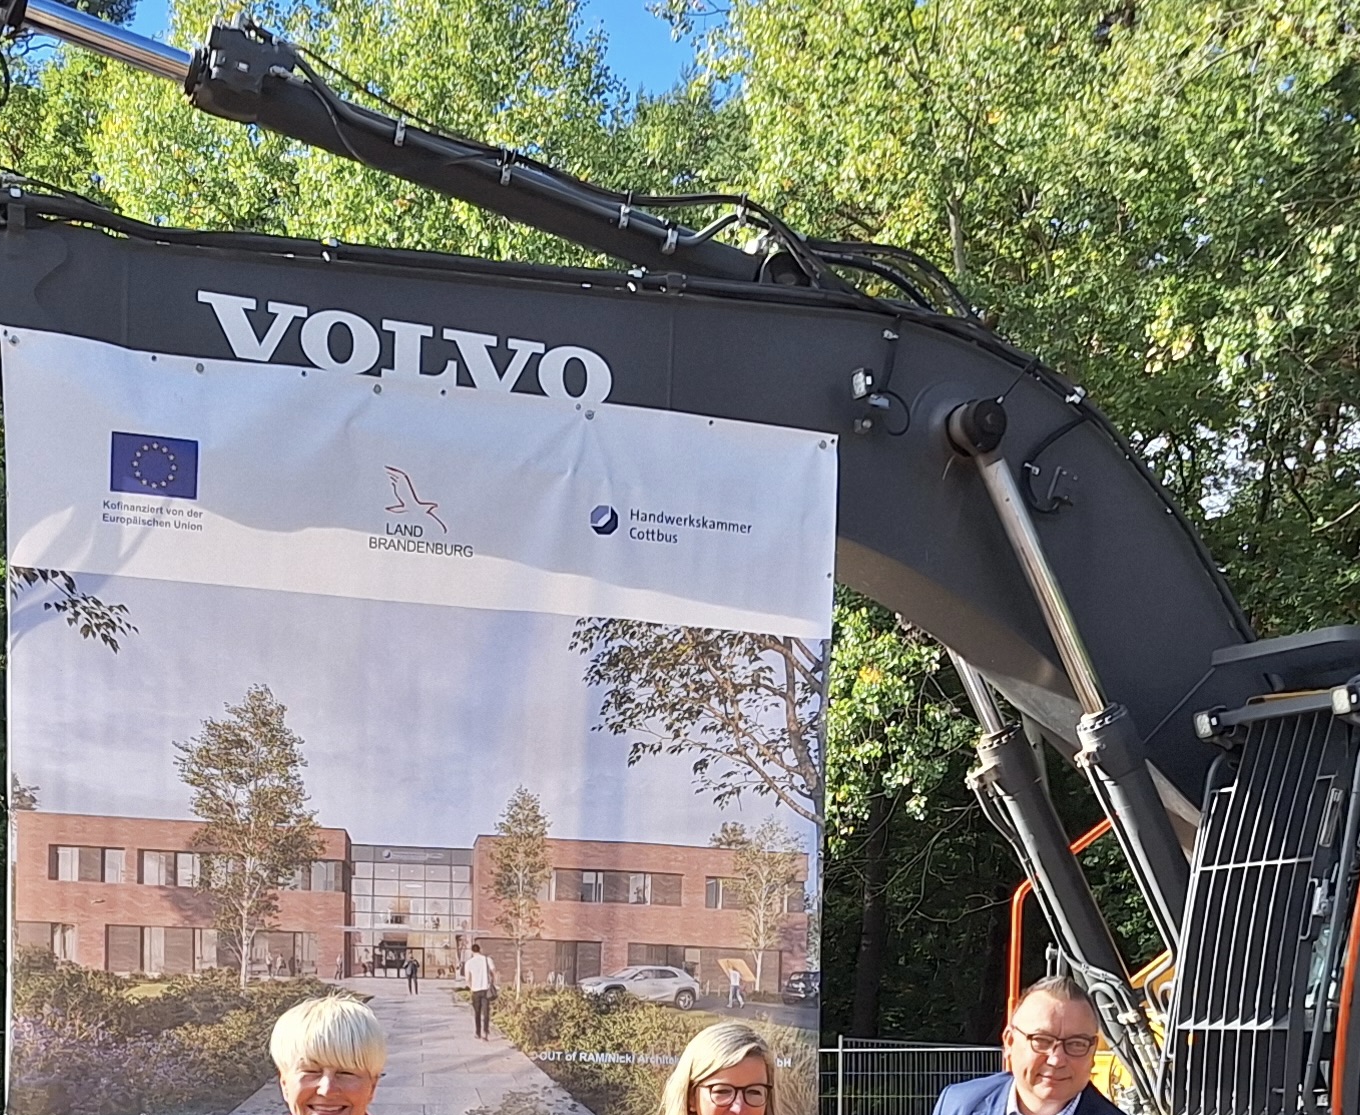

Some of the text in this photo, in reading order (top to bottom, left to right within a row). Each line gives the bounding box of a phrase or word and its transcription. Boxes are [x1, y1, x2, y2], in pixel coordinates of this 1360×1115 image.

[197, 290, 613, 404] VOLVO
[103, 500, 203, 519] Kofinanziert von der
[102, 513, 202, 531] Europäischen Union
[630, 508, 752, 534] Handwerkskammer
[386, 523, 423, 538] LAND
[629, 527, 678, 544] Cottbus
[369, 536, 473, 558] BRANDENBURG
[565, 1051, 577, 1061] of
[637, 1054, 680, 1065] Architek
[776, 1057, 792, 1067] bH
